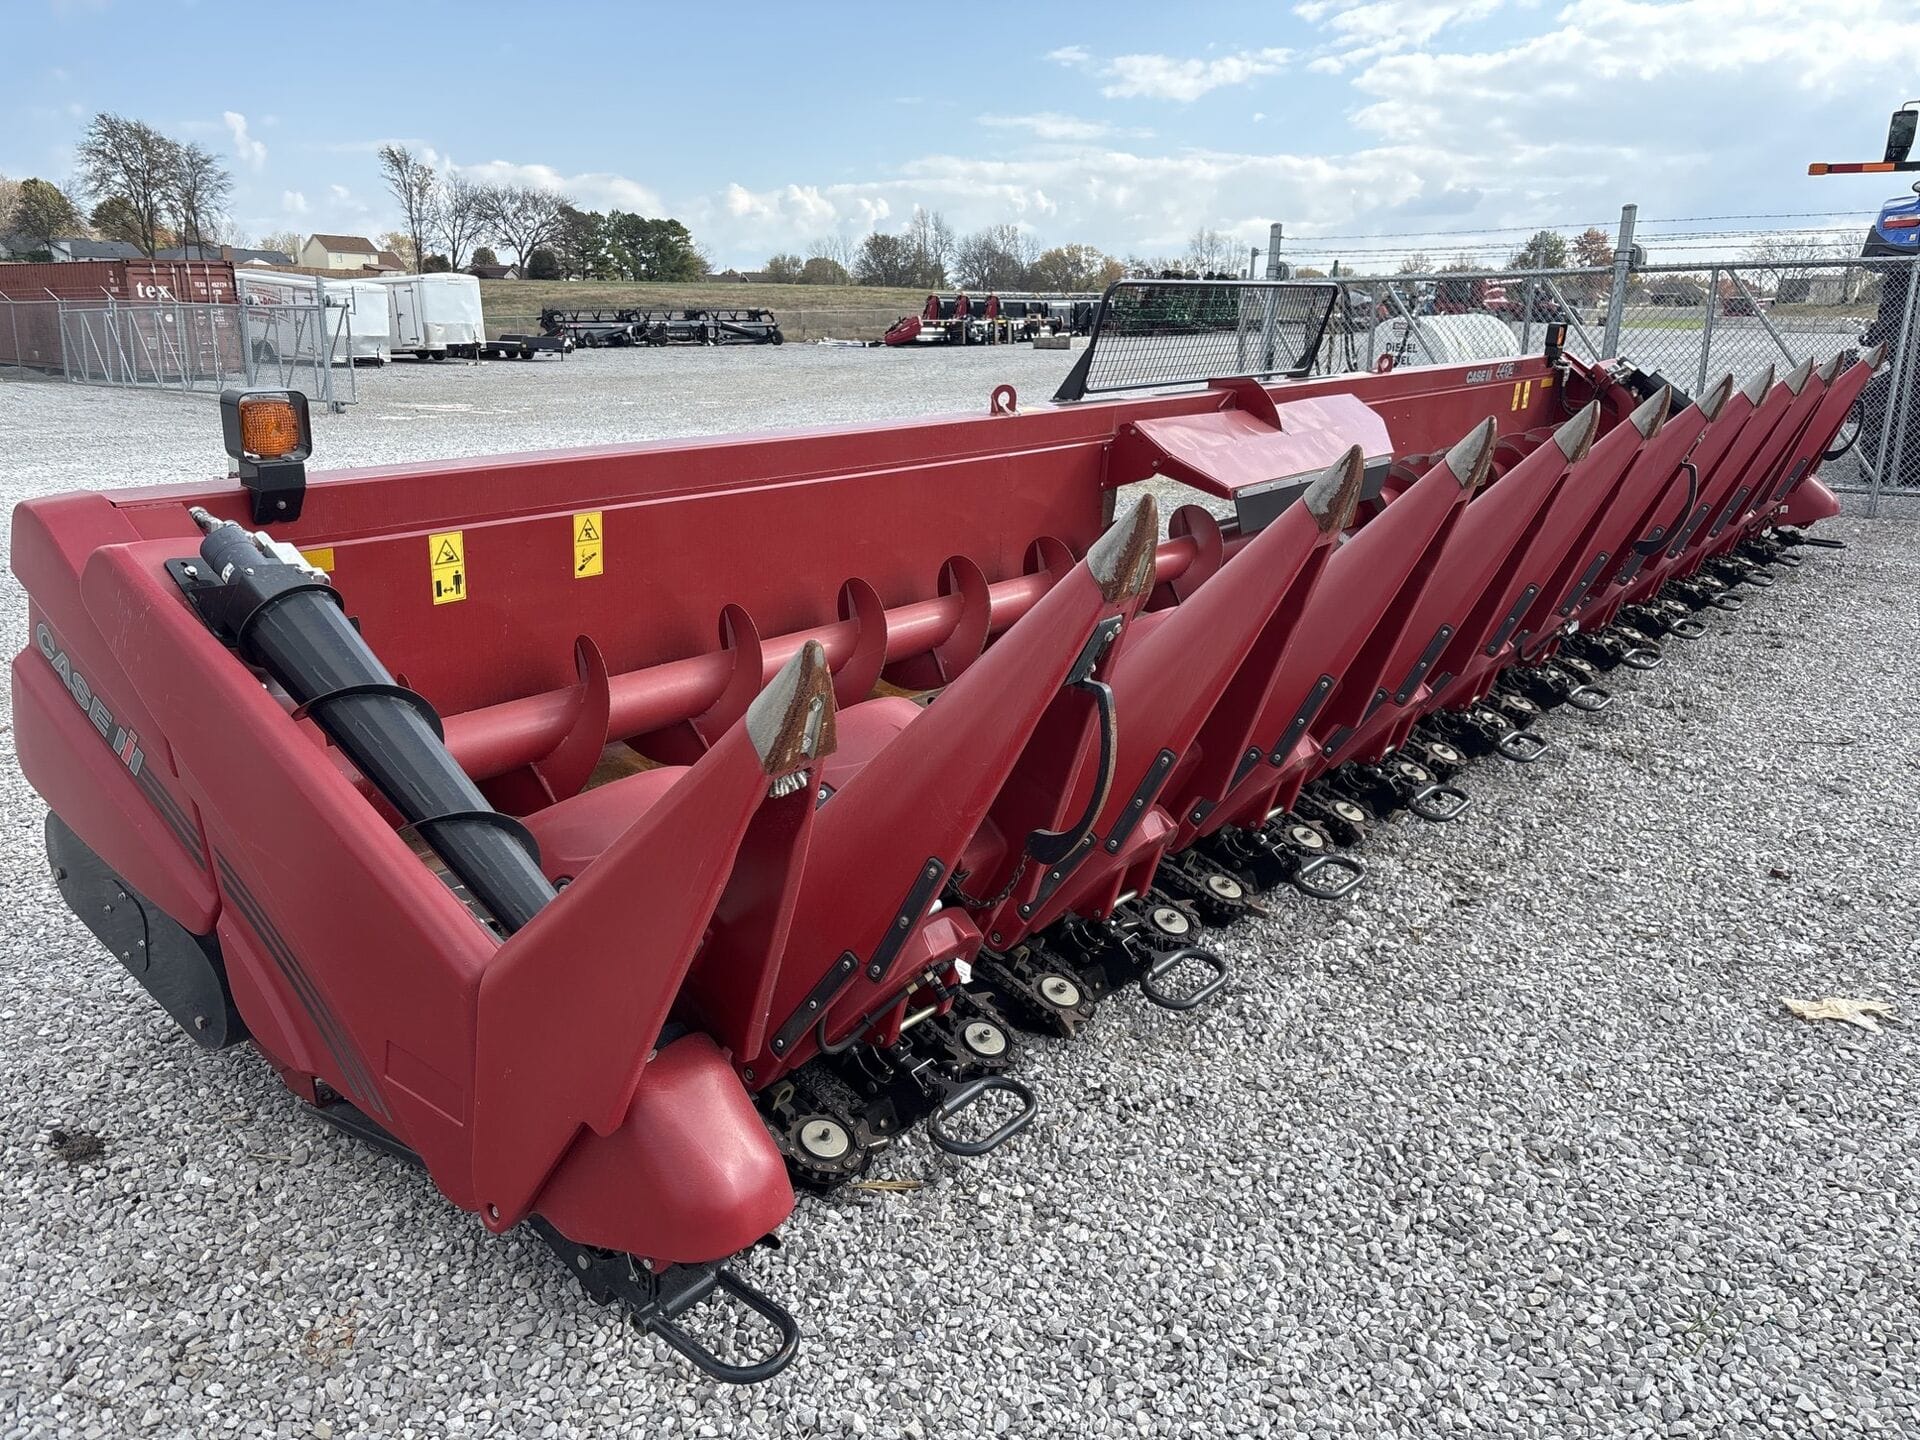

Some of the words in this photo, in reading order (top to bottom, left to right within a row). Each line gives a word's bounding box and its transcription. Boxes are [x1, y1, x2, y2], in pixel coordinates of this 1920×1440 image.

[136, 281, 170, 299] tex
[1386, 342, 1418, 353] DIEEL
[1466, 370, 1487, 384] CASE
[36, 623, 113, 738] CASE
